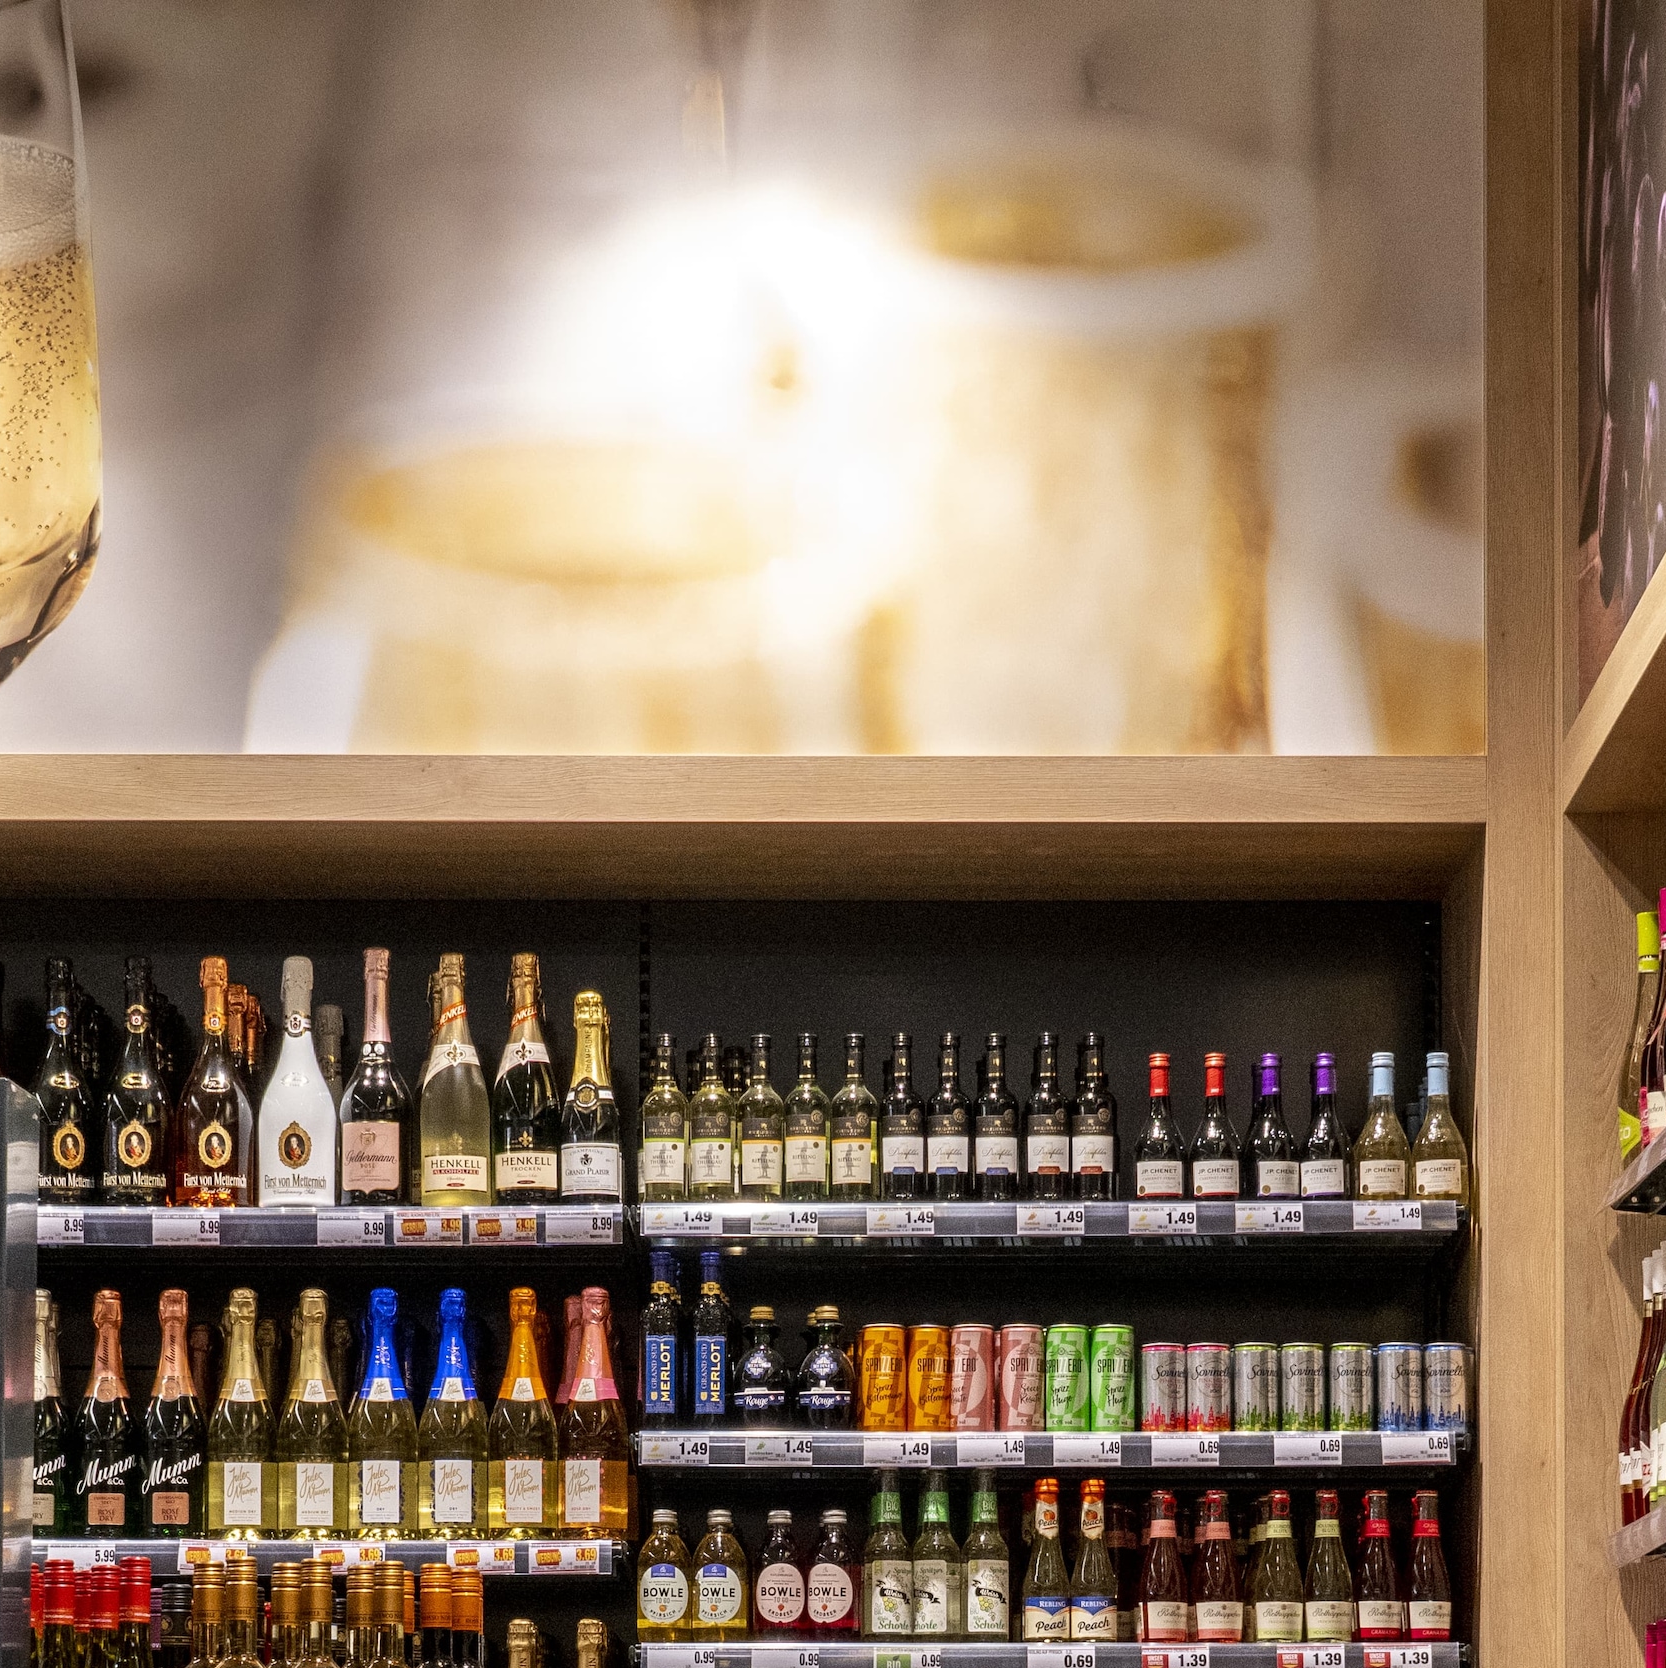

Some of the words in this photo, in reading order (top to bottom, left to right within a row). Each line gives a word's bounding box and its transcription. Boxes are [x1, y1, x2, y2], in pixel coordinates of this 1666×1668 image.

[584, 1027, 593, 1073] CHAMPAGNE
[345, 1152, 398, 1168] Geldermann
[431, 1159, 482, 1169] HENKELL
[501, 1156, 552, 1166] HENKELL
[565, 1168, 586, 1176] GRAND
[587, 1168, 610, 1176] PLAISIR
[1311, 1166, 1338, 1174] CHENET
[1374, 1166, 1401, 1175] CHENET
[119, 1175, 132, 1186] von
[133, 1172, 167, 1187] Metternich
[199, 1175, 212, 1187] von
[213, 1173, 247, 1188] Metternich
[683, 1211, 712, 1222] 1.49
[789, 1211, 817, 1223] 1.49
[905, 1211, 933, 1223] 1.49
[1055, 1210, 1083, 1223] 1.49
[1166, 1211, 1195, 1224] 1.49
[64, 1219, 84, 1232] 8.99
[200, 1221, 220, 1234] 8.99
[364, 1222, 384, 1235] 8.99
[441, 1219, 461, 1232] 3.99
[592, 1218, 612, 1230] 8.99
[650, 1343, 658, 1359] SUD
[650, 1360, 658, 1390] GRAND
[661, 1343, 671, 1402] MERLOT
[710, 1344, 721, 1402] MERLOT
[745, 1394, 769, 1408] Rouge
[811, 1394, 835, 1408] Rouge
[1199, 1441, 1219, 1454] 0.69
[1321, 1440, 1340, 1452] 0.69
[1429, 1436, 1448, 1450] 0.69
[76, 1454, 136, 1495] Mumm
[142, 1452, 202, 1495] Mumm
[982, 1500, 996, 1511] BIO
[94, 1550, 115, 1562] 5.99
[494, 1548, 515, 1561] 3.69
[643, 1587, 684, 1598] BOWLE
[761, 1587, 801, 1598] BOWLE
[1080, 1600, 1109, 1608] REBLING
[974, 1619, 1005, 1631] Schorle
[1035, 1619, 1067, 1634] Peach
[1077, 1616, 1111, 1634] Peach
[694, 1651, 714, 1664] 0.99
[799, 1654, 819, 1667] 0.99
[921, 1655, 941, 1668] 0.99
[1064, 1654, 1093, 1668] 0.69
[1178, 1654, 1207, 1667] 1.39
